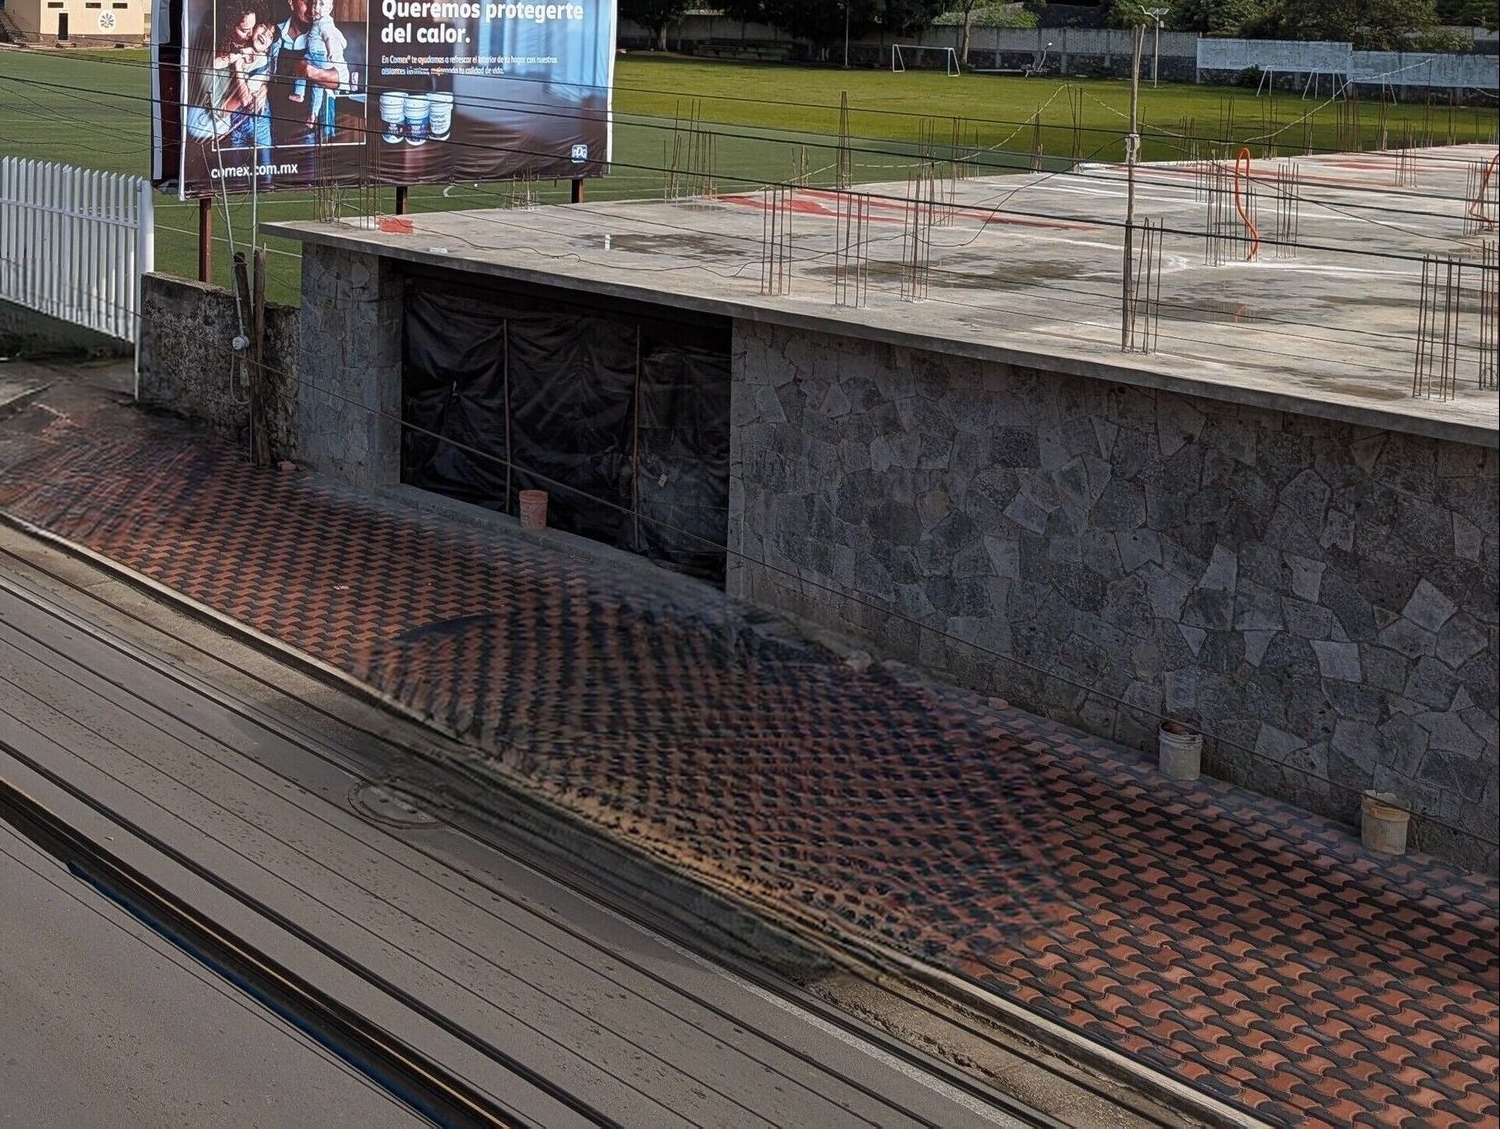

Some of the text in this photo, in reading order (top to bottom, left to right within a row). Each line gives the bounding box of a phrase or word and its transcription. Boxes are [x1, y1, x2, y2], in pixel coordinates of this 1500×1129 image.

[485, 2, 584, 24] protegerte
[381, 23, 470, 43] del calor.
[381, 55, 389, 63] En
[411, 55, 418, 63] te
